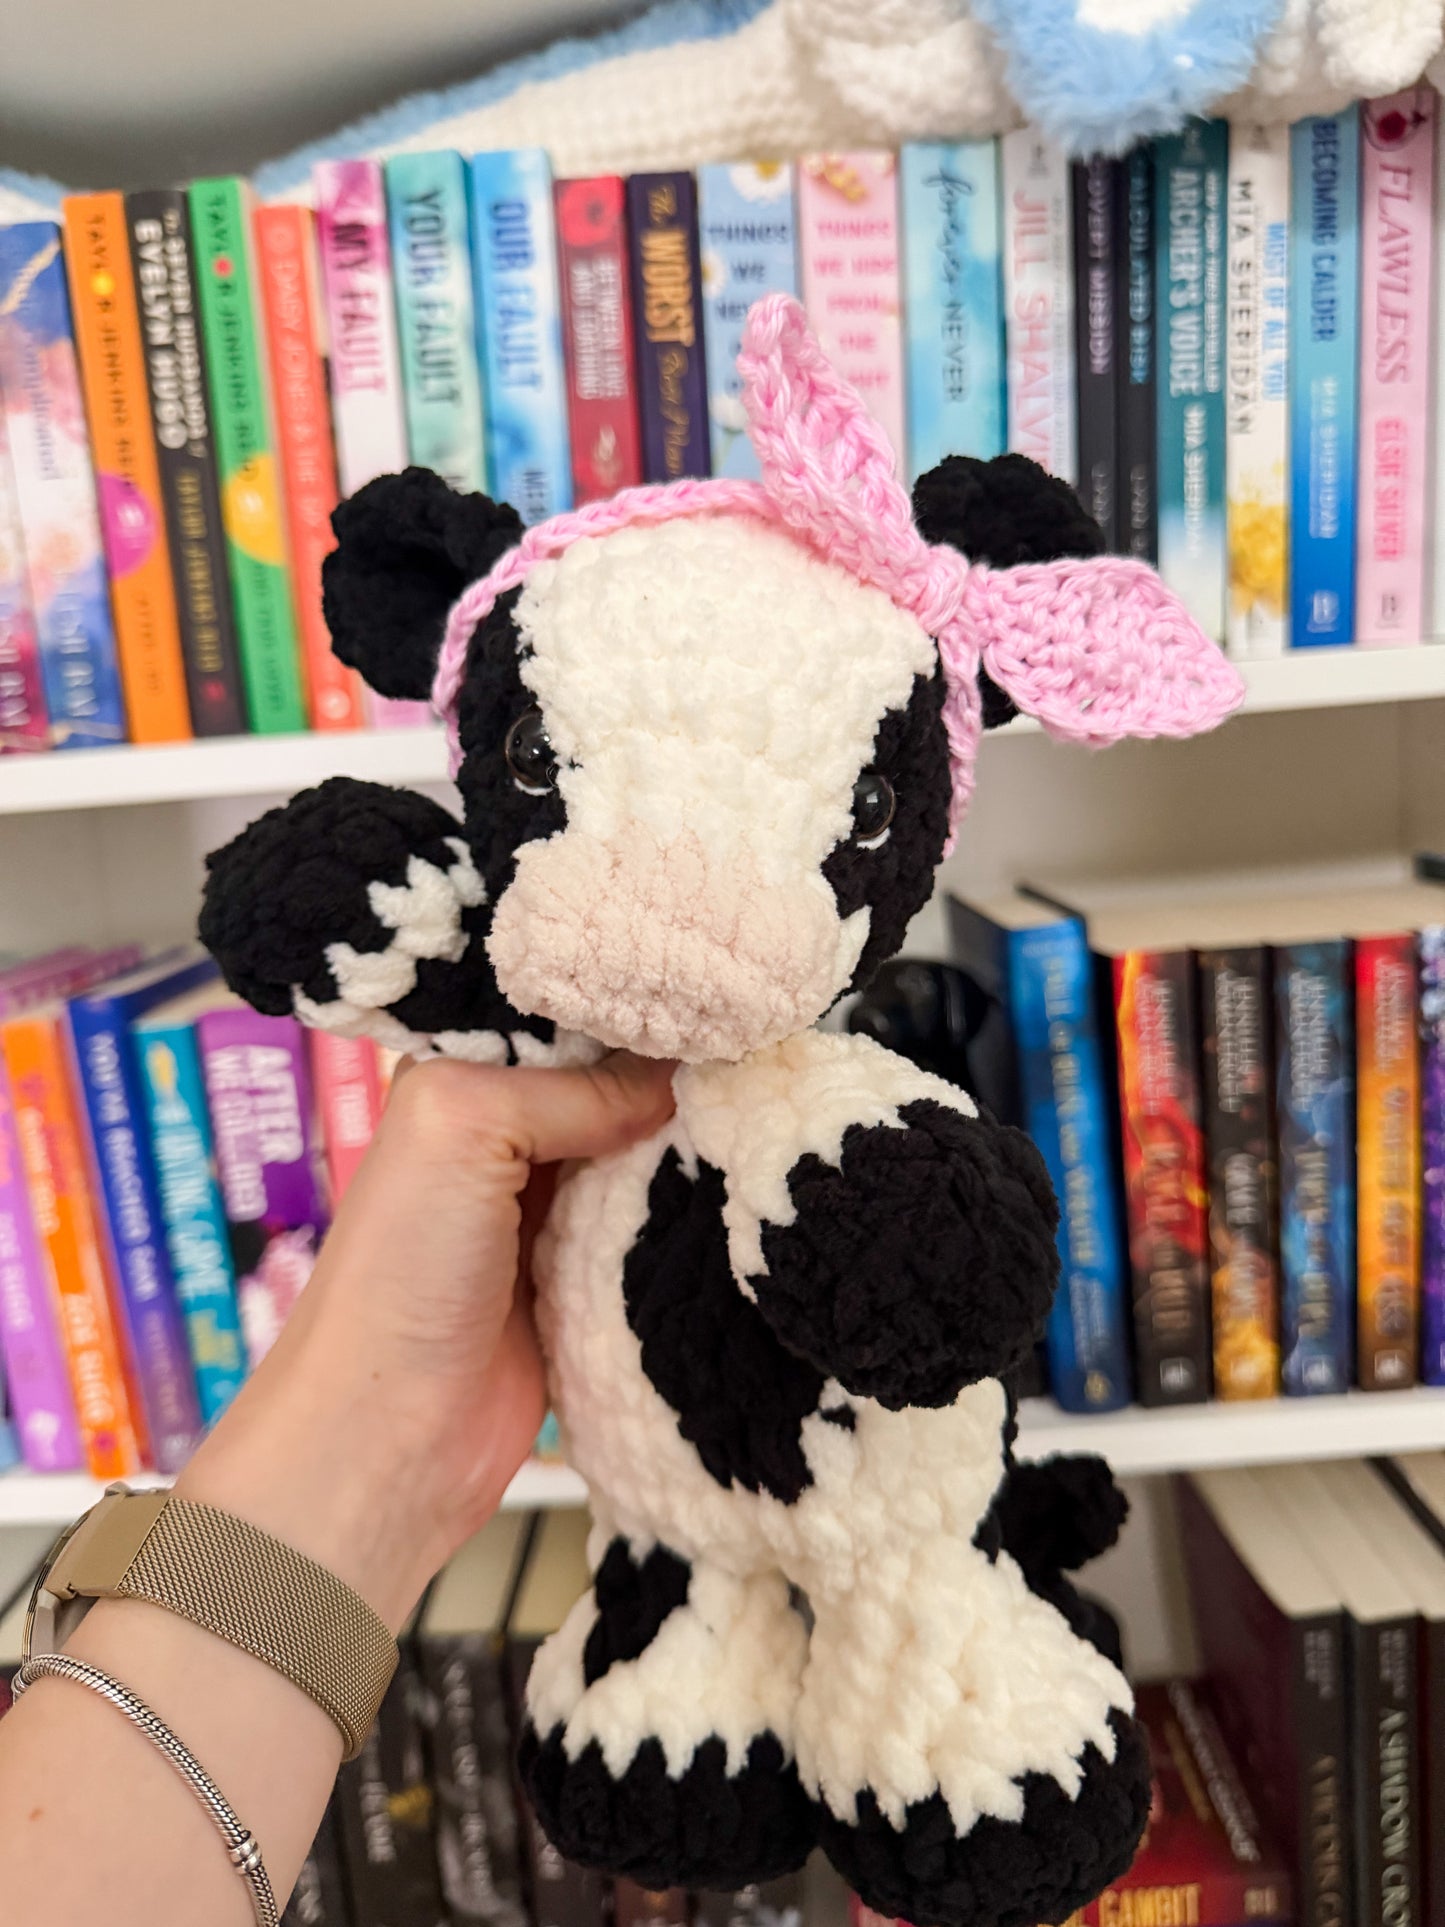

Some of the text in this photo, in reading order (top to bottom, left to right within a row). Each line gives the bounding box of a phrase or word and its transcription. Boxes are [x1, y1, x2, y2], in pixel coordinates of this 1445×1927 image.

[1012, 190, 1048, 281] JILL
[1168, 168, 1202, 310] ARCHER'S
[1230, 178, 1258, 247] MIA
[1262, 222, 1287, 279] MOST
[1311, 121, 1339, 343] BECOMING CALDER
[167, 237, 193, 317] SEVEN
[332, 220, 386, 393] MY FAULT
[404, 188, 460, 406] YOUR FAULT
[490, 200, 543, 391] OUR FAULT
[641, 229, 695, 347] WORST
[1088, 267, 1114, 375] MISSION
[1263, 286, 1288, 309] OF
[1375, 162, 1413, 386] FLAWLESS
[135, 218, 190, 450] EVELYN HUGO
[175, 320, 207, 438] HUSBANDS
[286, 336, 316, 421] JONES
[940, 303, 968, 403] NEVER
[1129, 324, 1152, 385] RISK
[1168, 311, 1202, 398] VOICE
[1231, 257, 1258, 437] SHERIDAN
[1263, 318, 1288, 351] ALL
[1374, 416, 1408, 563] ELSIE SILVER
[246, 1044, 304, 1164] AFTER
[1378, 1734, 1410, 1861] SHADOW
